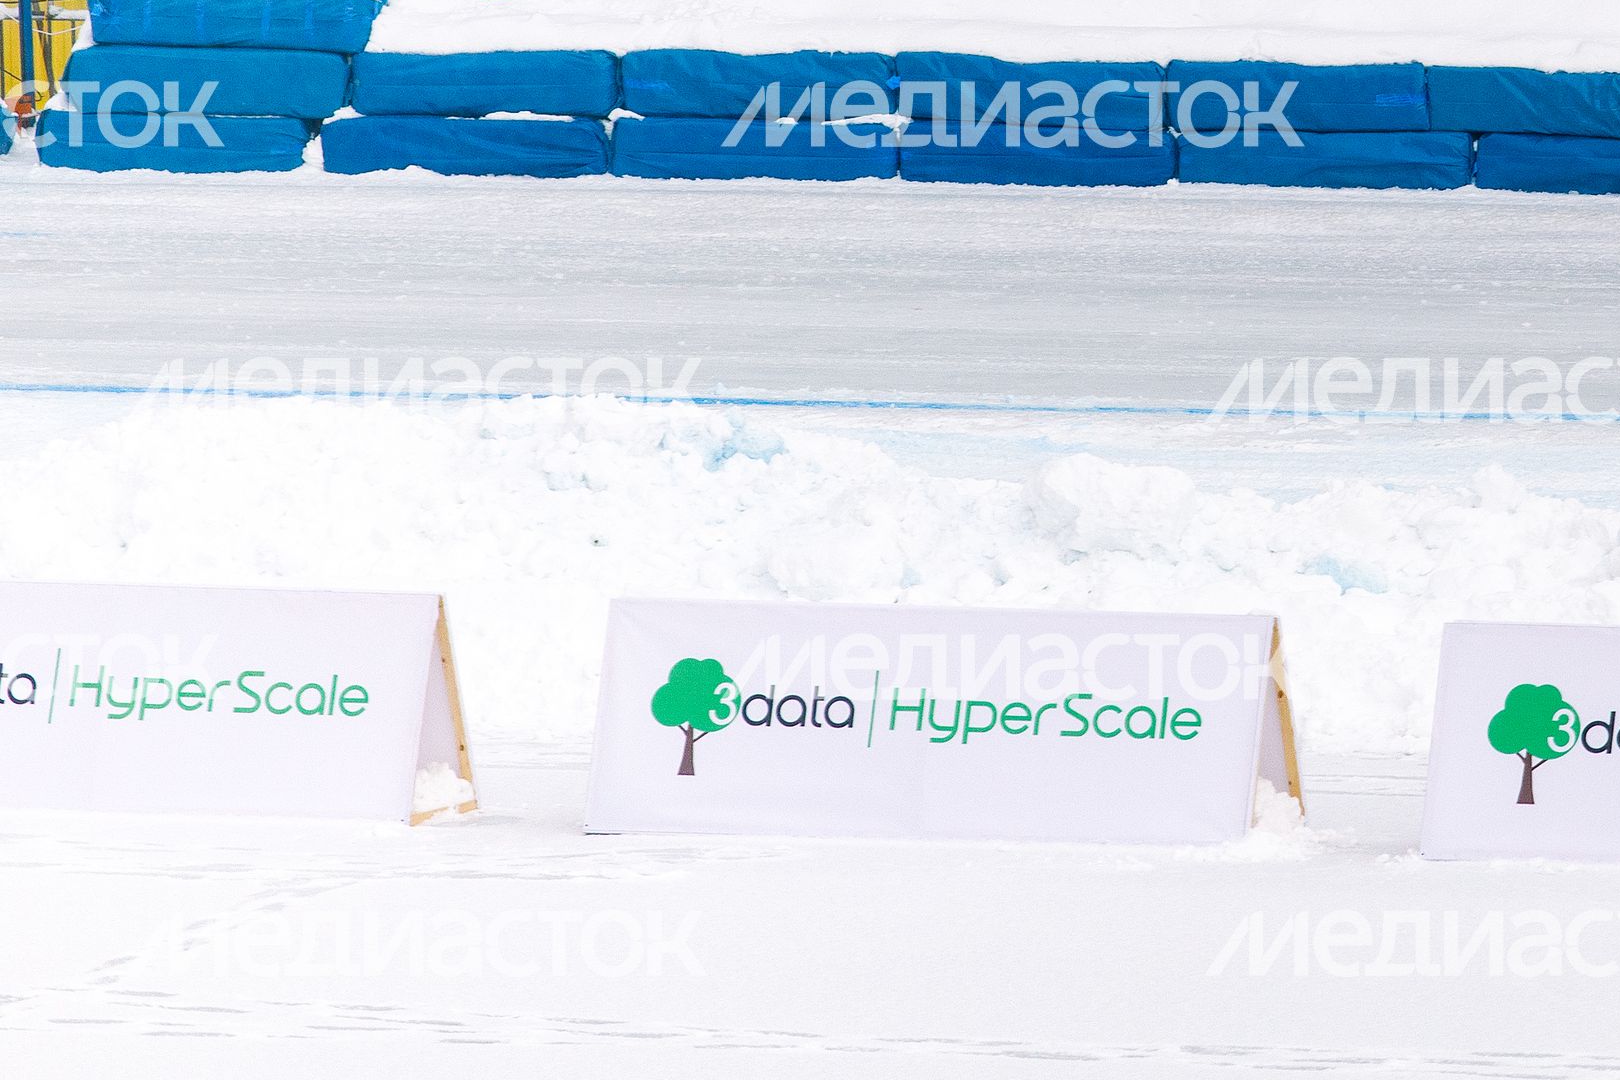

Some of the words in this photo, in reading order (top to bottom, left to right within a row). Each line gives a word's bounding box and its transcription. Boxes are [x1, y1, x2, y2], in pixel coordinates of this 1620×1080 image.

[69, 664, 370, 721] HyperScale
[708, 681, 855, 732] 3data
[888, 687, 1202, 745] HyperScale
